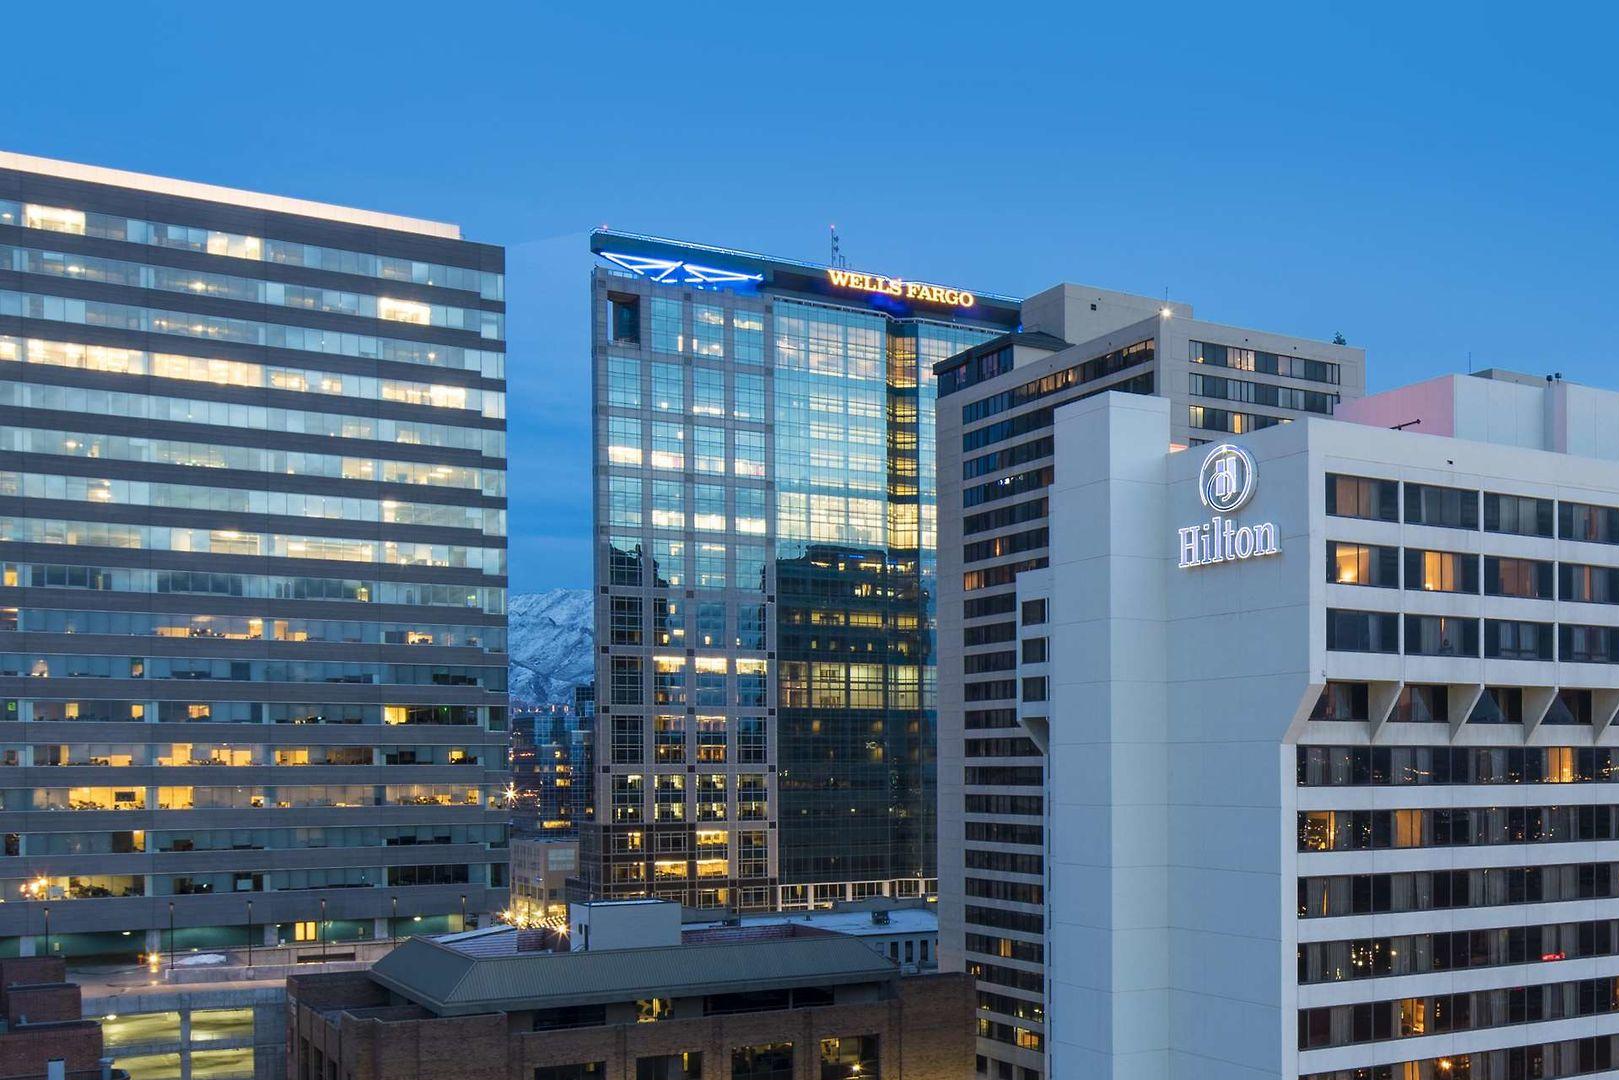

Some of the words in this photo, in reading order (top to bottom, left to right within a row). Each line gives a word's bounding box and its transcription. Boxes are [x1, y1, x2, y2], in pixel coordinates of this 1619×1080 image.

[828, 270, 901, 296] WELLS
[906, 284, 974, 308] FARGO
[1178, 516, 1278, 569] Hilton
